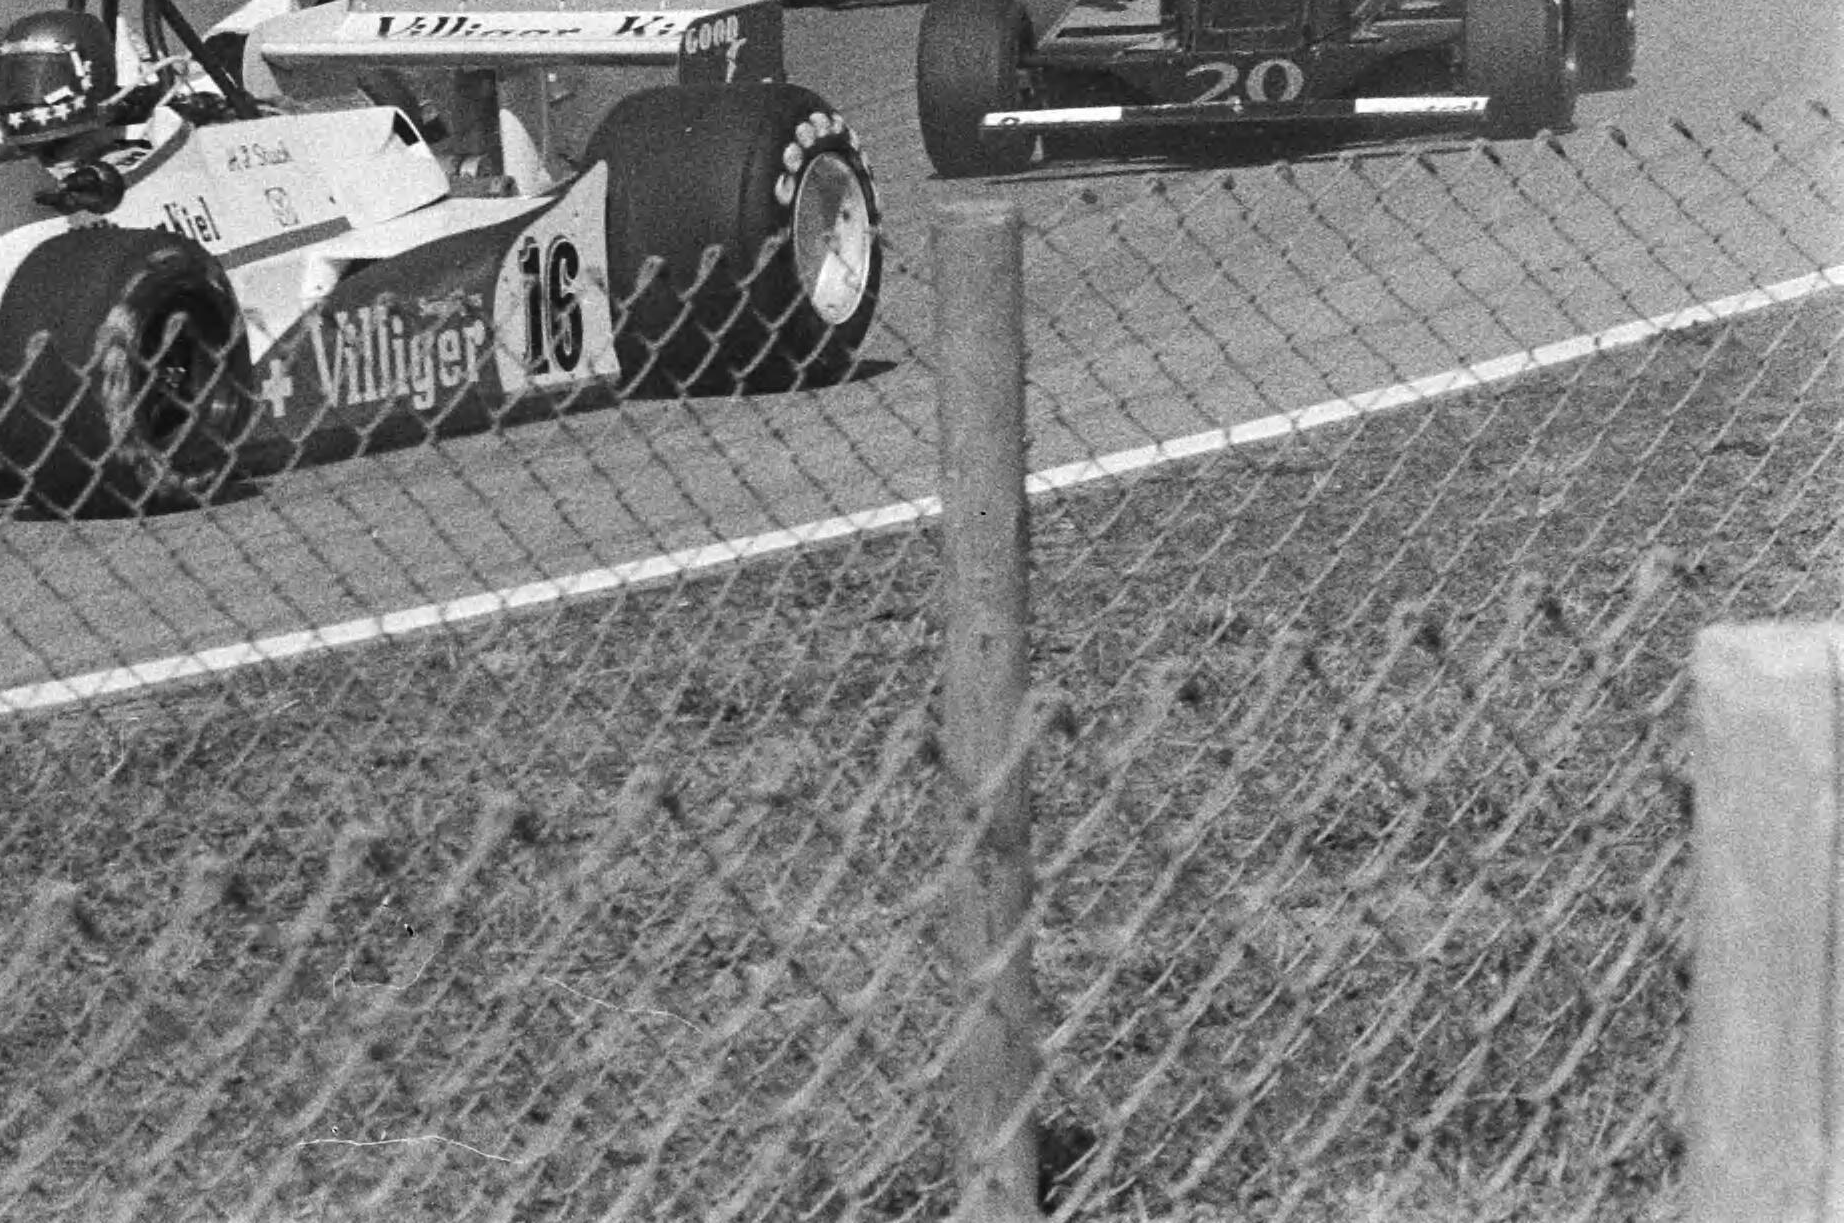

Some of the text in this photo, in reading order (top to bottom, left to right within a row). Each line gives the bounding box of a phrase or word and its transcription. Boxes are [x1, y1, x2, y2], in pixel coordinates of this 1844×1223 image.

[1185, 57, 1305, 104] 20
[303, 304, 486, 410] Villiger
[519, 235, 584, 375] 16
